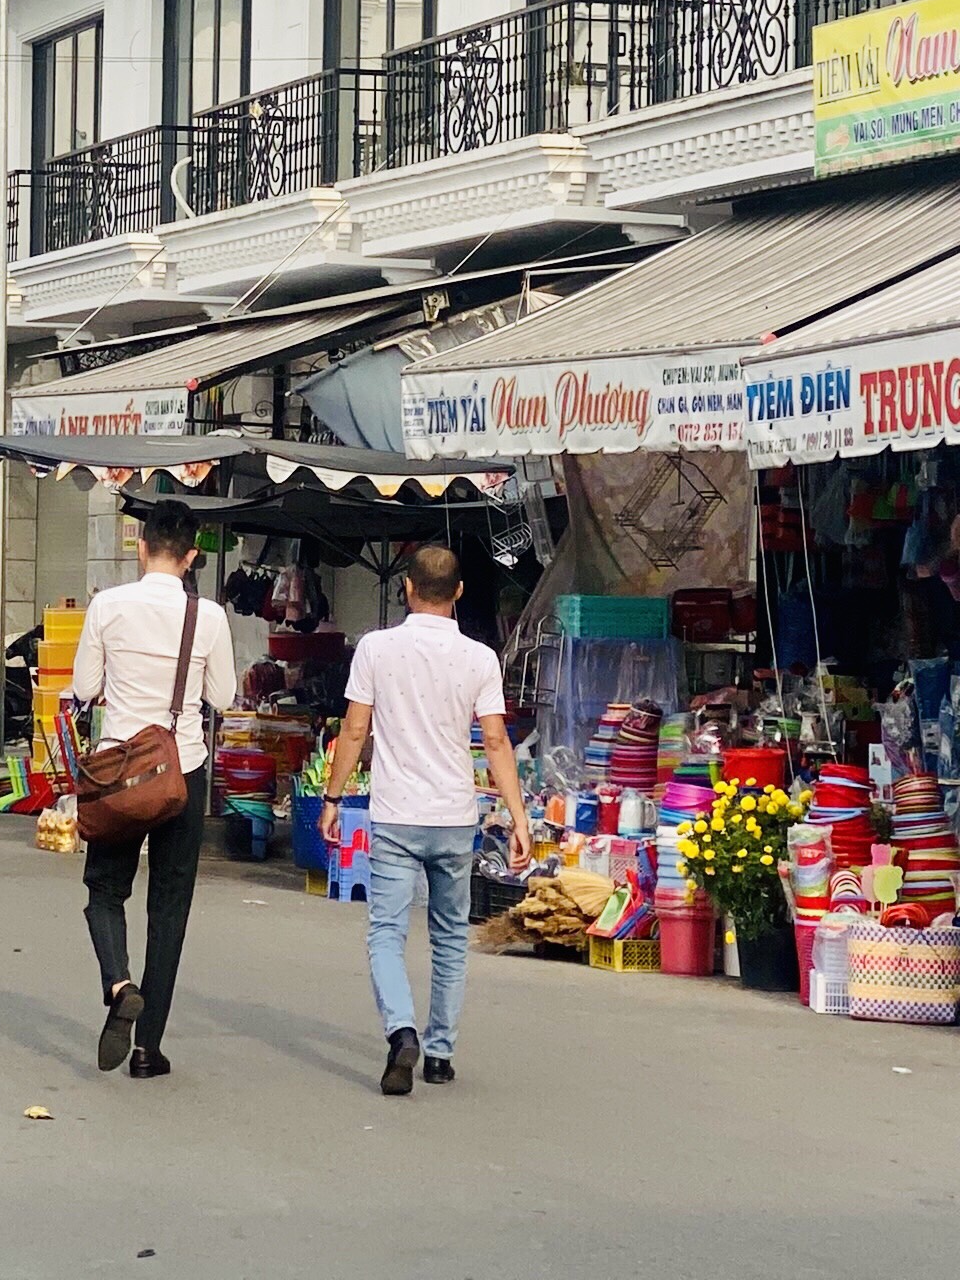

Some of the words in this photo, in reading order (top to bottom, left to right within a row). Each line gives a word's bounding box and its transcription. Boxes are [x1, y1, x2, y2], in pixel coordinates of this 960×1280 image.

[886, 11, 960, 87] Nam
[427, 387, 458, 443] TIỆM
[460, 379, 487, 433] VẢI
[491, 375, 550, 433] Nam
[555, 369, 653, 443] Phương
[747, 371, 794, 431] TIỆM
[800, 362, 851, 422] ĐIỆN
